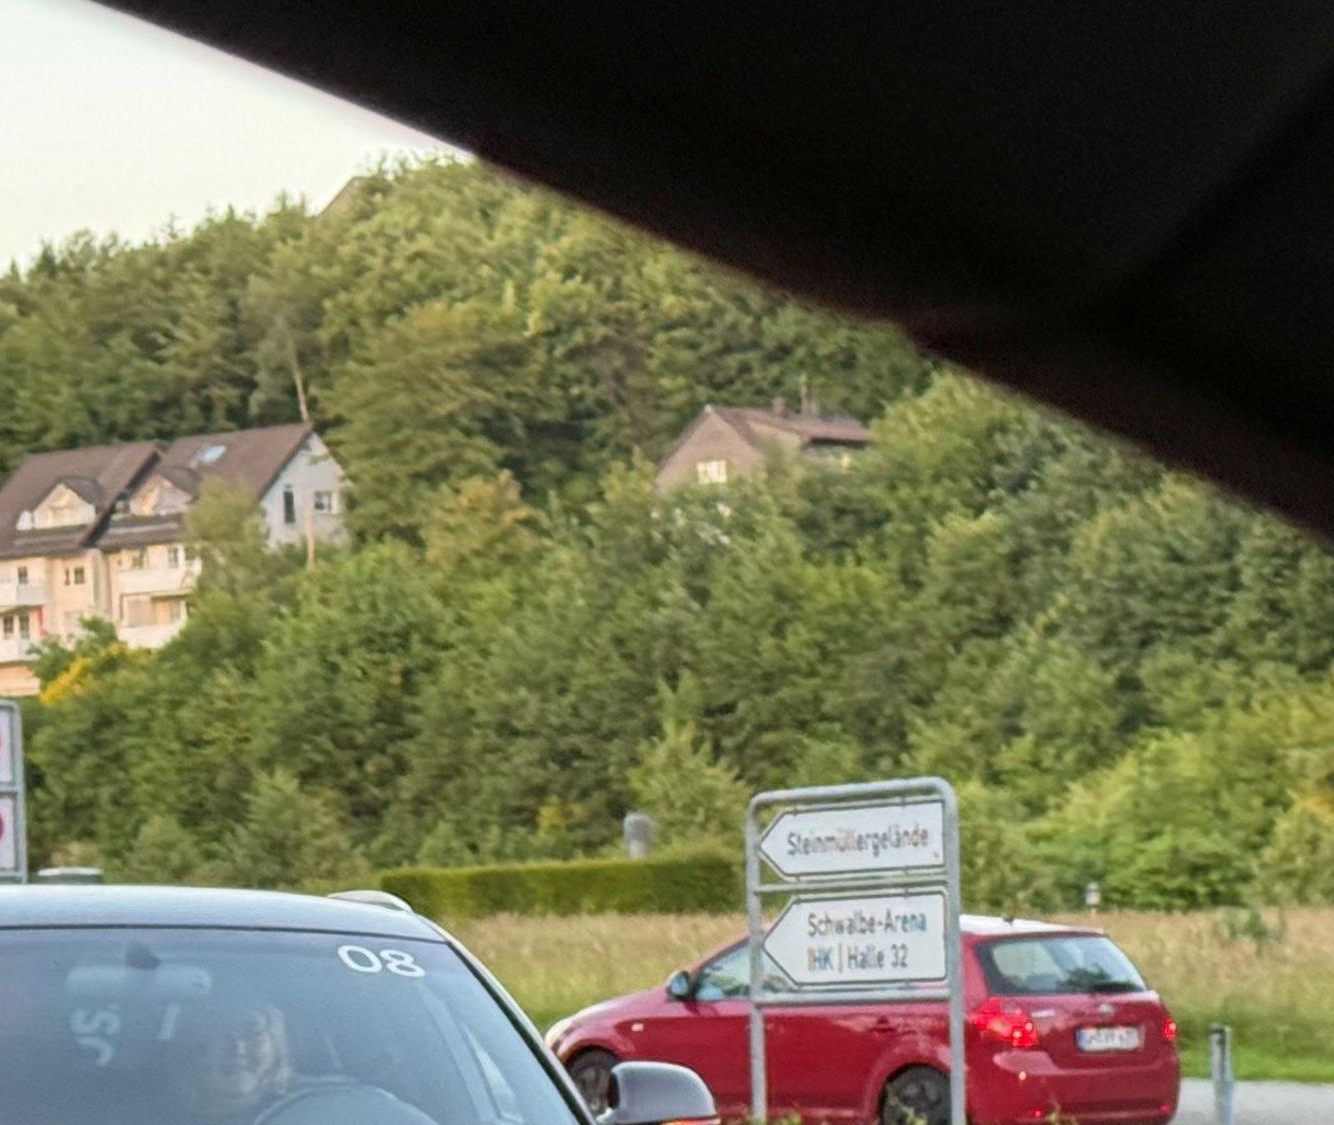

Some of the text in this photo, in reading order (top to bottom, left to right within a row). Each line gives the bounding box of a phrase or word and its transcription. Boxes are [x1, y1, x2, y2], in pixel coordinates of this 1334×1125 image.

[787, 822, 929, 857] Steinmüllergelände
[807, 908, 927, 937] Schwalbe-Arena
[337, 945, 426, 977] 08
[807, 947, 834, 972] IHK
[847, 945, 885, 970] Halle
[890, 943, 909, 969] 32
